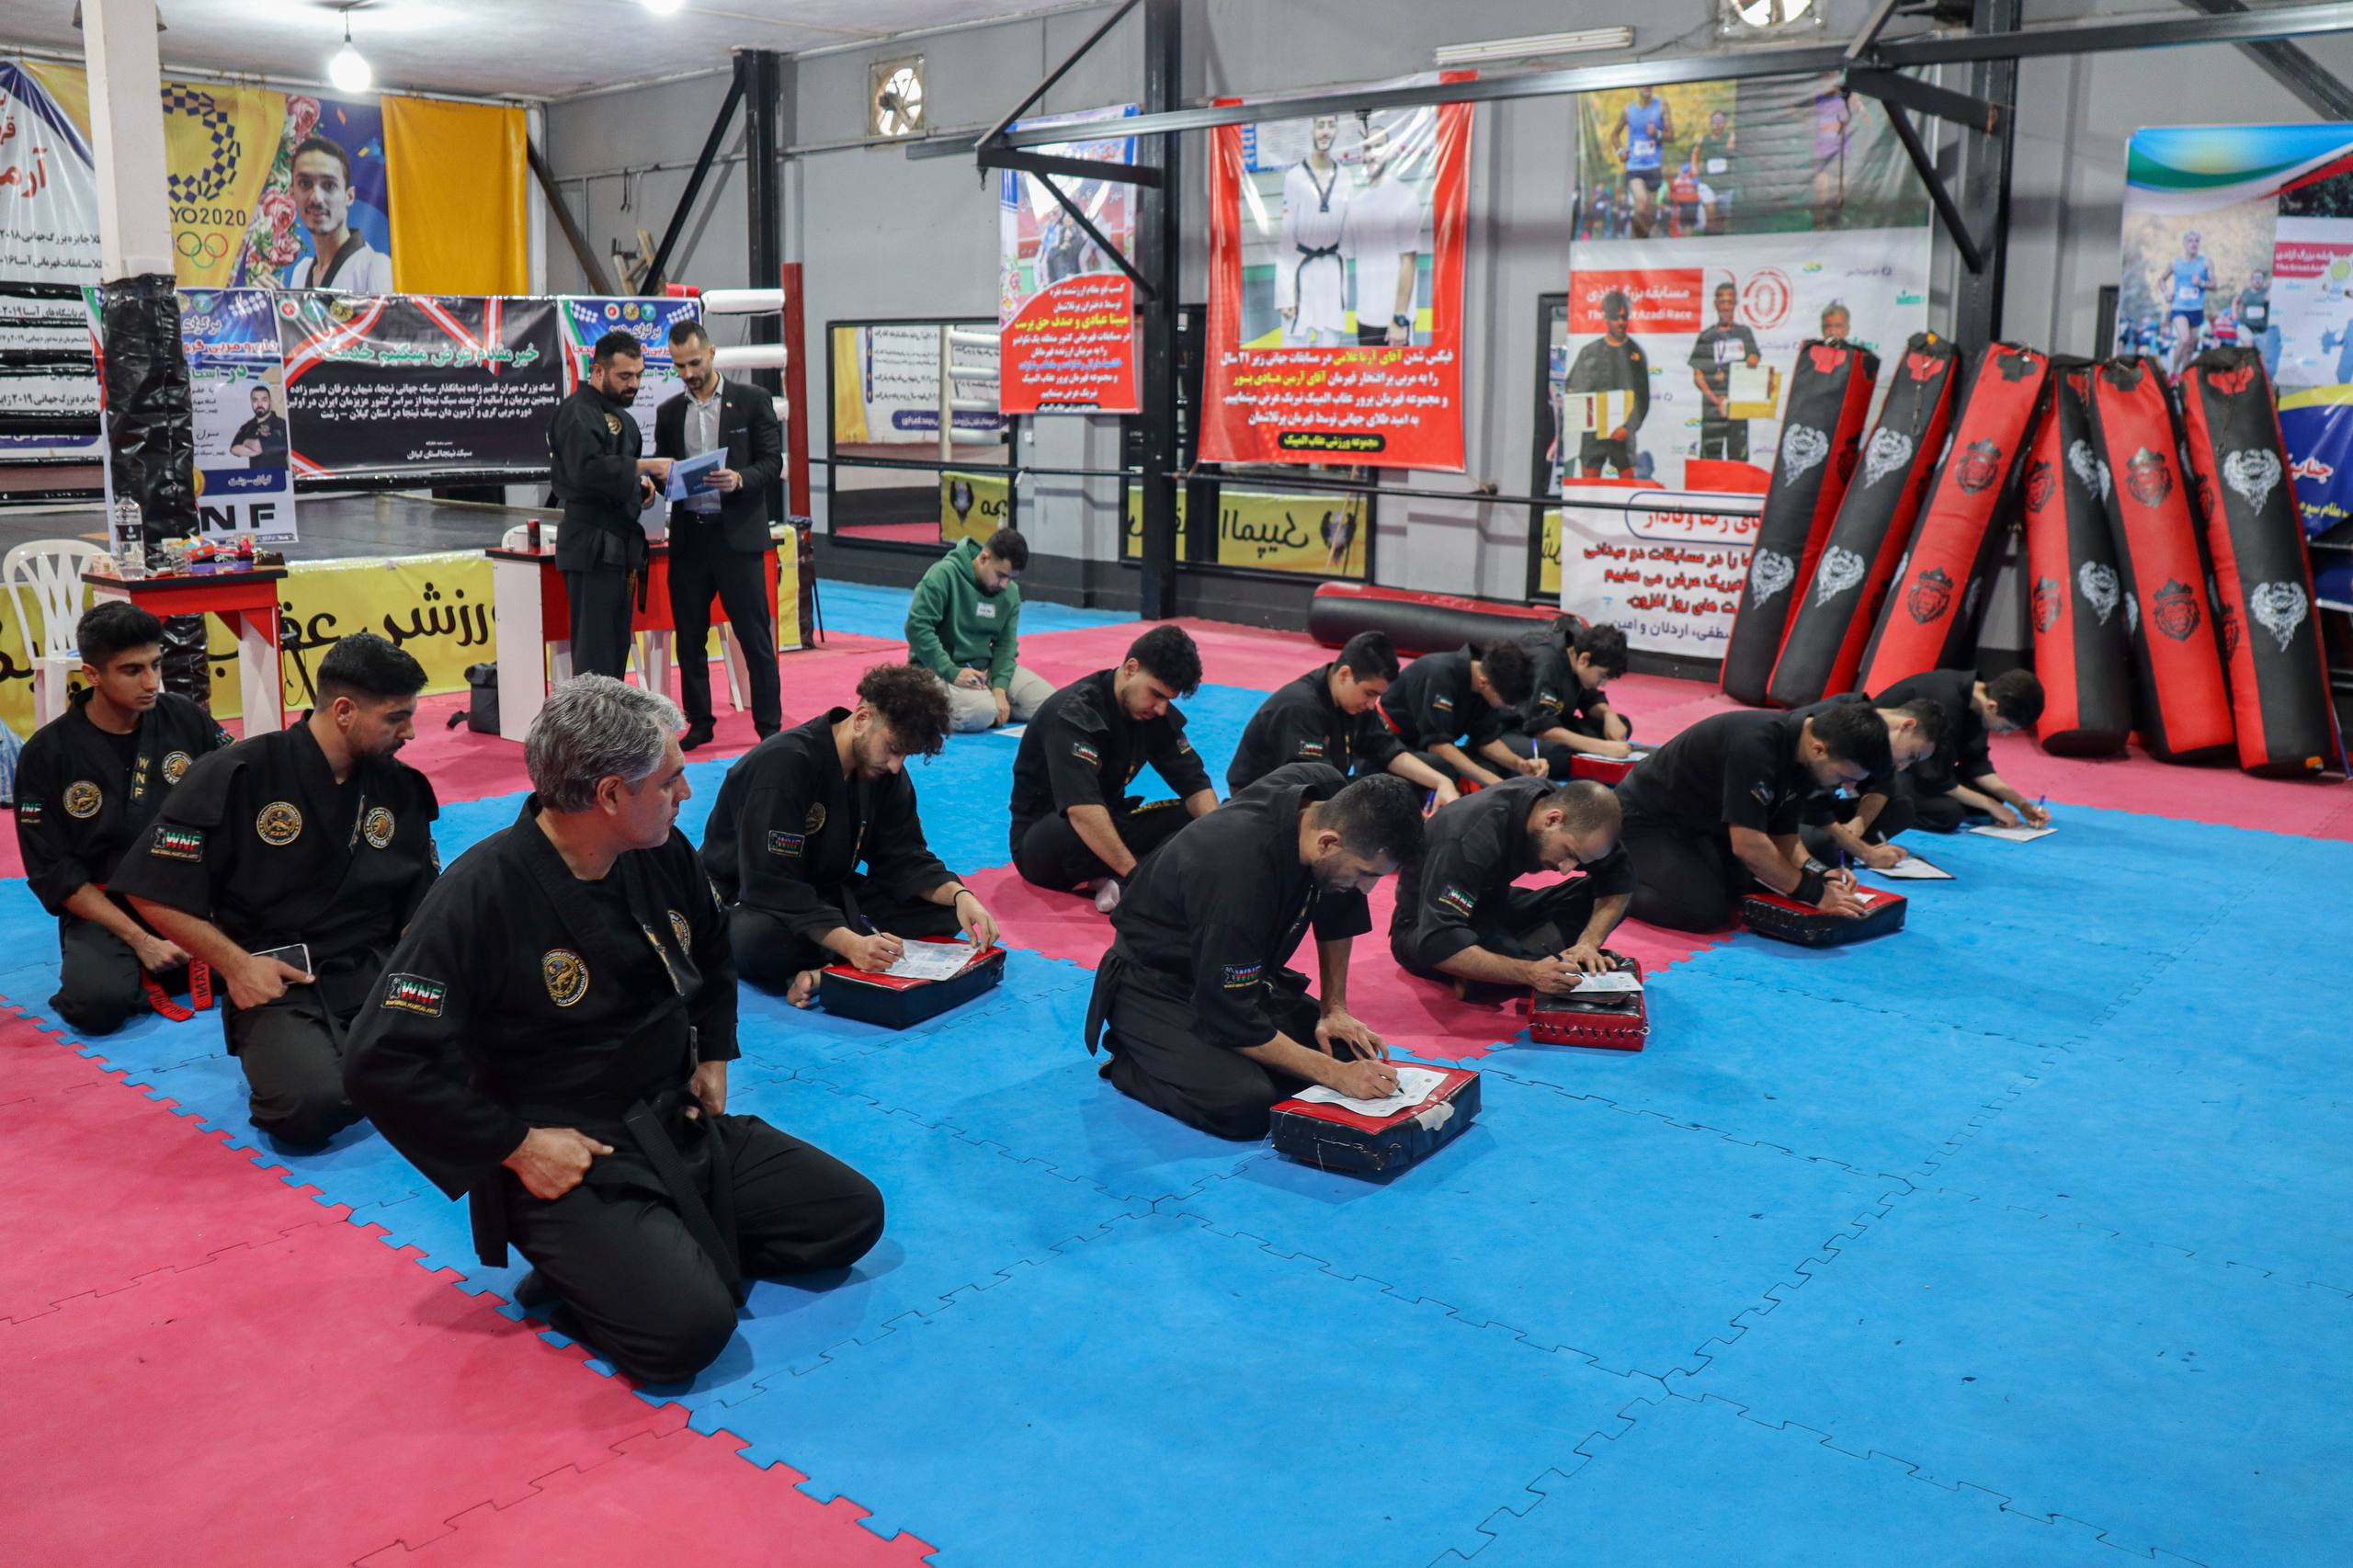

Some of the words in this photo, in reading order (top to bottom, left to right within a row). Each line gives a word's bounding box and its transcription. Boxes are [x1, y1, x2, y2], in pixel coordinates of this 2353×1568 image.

[169, 206, 197, 223] YO
[199, 207, 246, 226] 2020
[1644, 285, 1691, 301] مسابقه
[1638, 308, 1666, 321] Azadi
[1666, 308, 1692, 321] Race
[1289, 351, 1320, 365] مسابقات
[1380, 348, 1403, 366] آقای
[191, 367, 220, 380] استا
[1306, 369, 1326, 387] آقای
[395, 383, 417, 395] جهانی
[418, 383, 437, 394] سبک
[499, 382, 519, 394] مهران
[519, 382, 539, 394] بزرگ
[538, 382, 555, 393] استاد
[439, 396, 458, 406] سبک
[1584, 541, 1627, 561] میدانی
[1629, 548, 1645, 562] دو
[1648, 546, 1705, 565] مسابقات
[1643, 573, 1663, 586] می
[1666, 571, 1700, 589] عرض
[1667, 594, 1689, 613] روز
[1692, 597, 1718, 616] های
[1650, 620, 1688, 640] اردلان
[165, 832, 203, 851] WNF
[401, 980, 442, 1006] WNF
